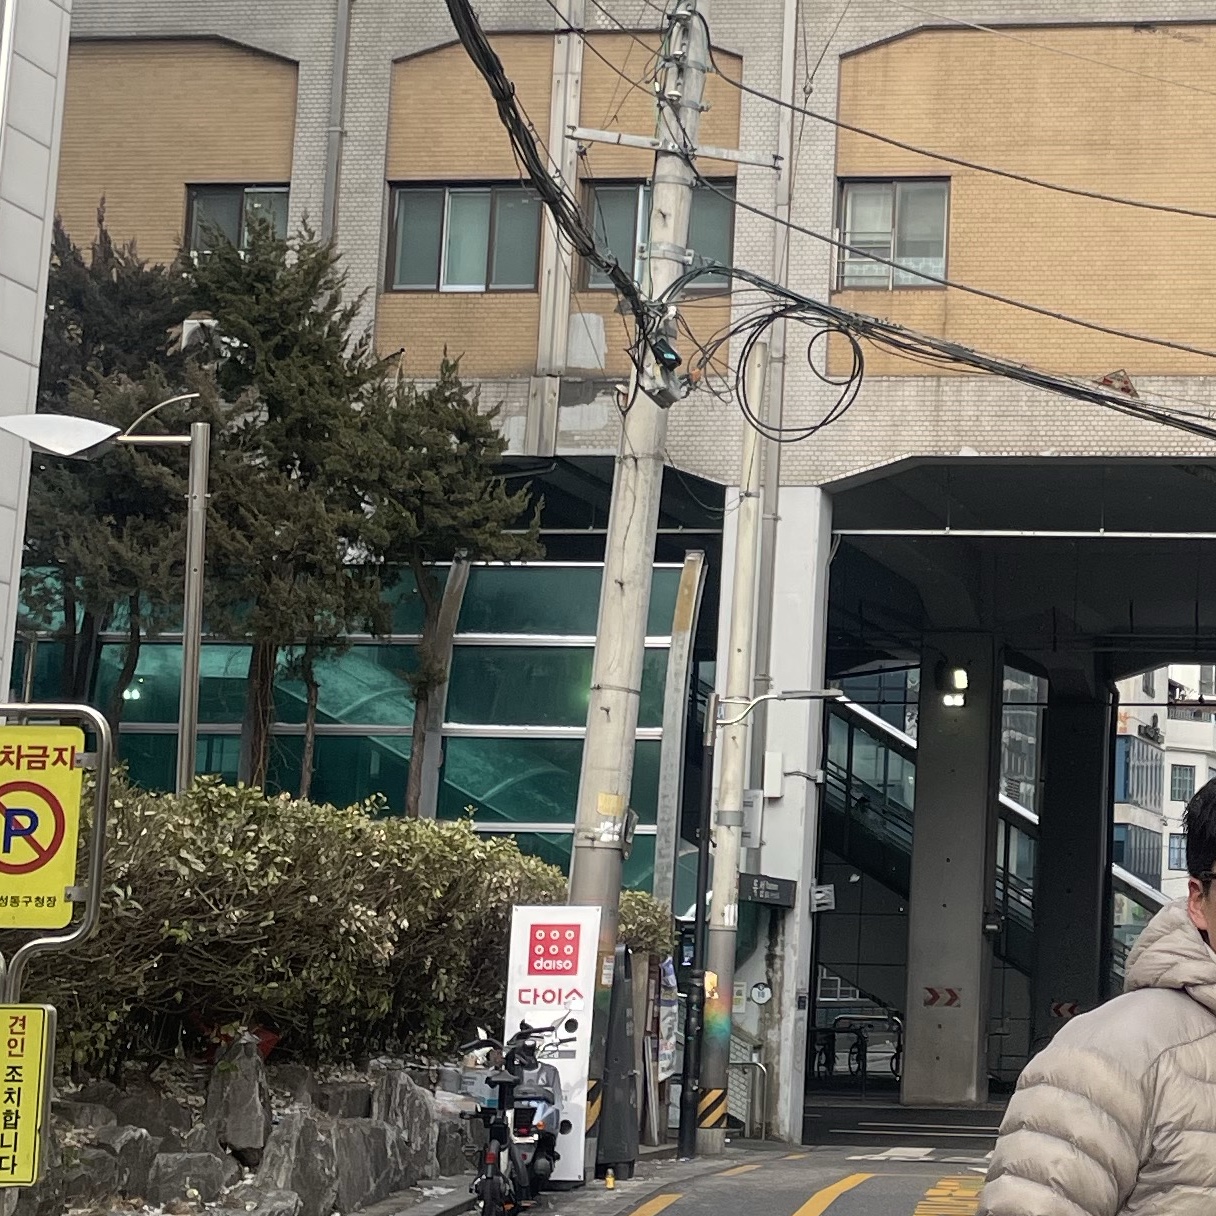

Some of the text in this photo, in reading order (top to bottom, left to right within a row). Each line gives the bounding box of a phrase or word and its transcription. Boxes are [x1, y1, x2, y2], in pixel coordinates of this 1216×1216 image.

[533, 957, 573, 970] daiso
[0, 1015, 27, 1175] 견인 조치합니다
